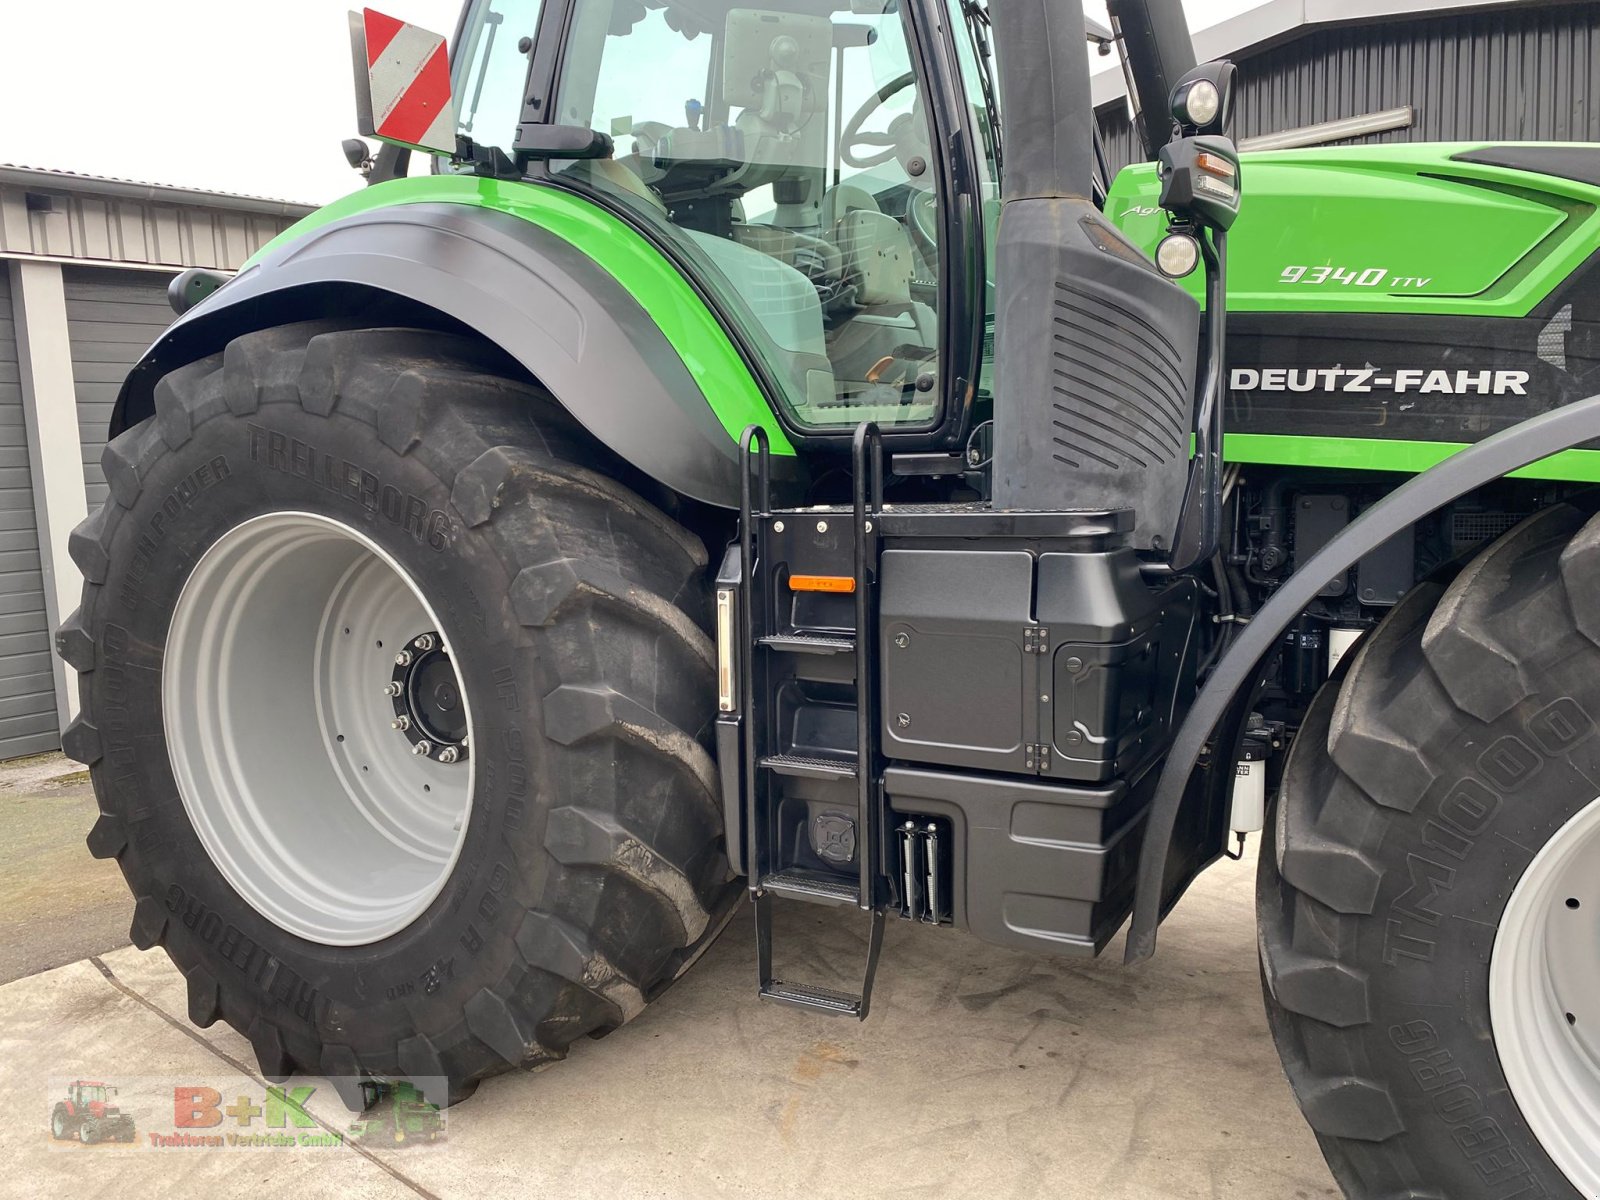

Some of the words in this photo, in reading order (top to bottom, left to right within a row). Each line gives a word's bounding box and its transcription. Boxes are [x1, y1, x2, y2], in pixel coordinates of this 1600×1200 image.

[1278, 266, 1388, 287] 9340
[1390, 277, 1432, 288] TTV
[1229, 368, 1530, 395] DEUTZ-FAHR
[150, 453, 233, 537] POWER
[246, 421, 453, 554] TRELLEBORG
[1382, 696, 1597, 967] TM1000
